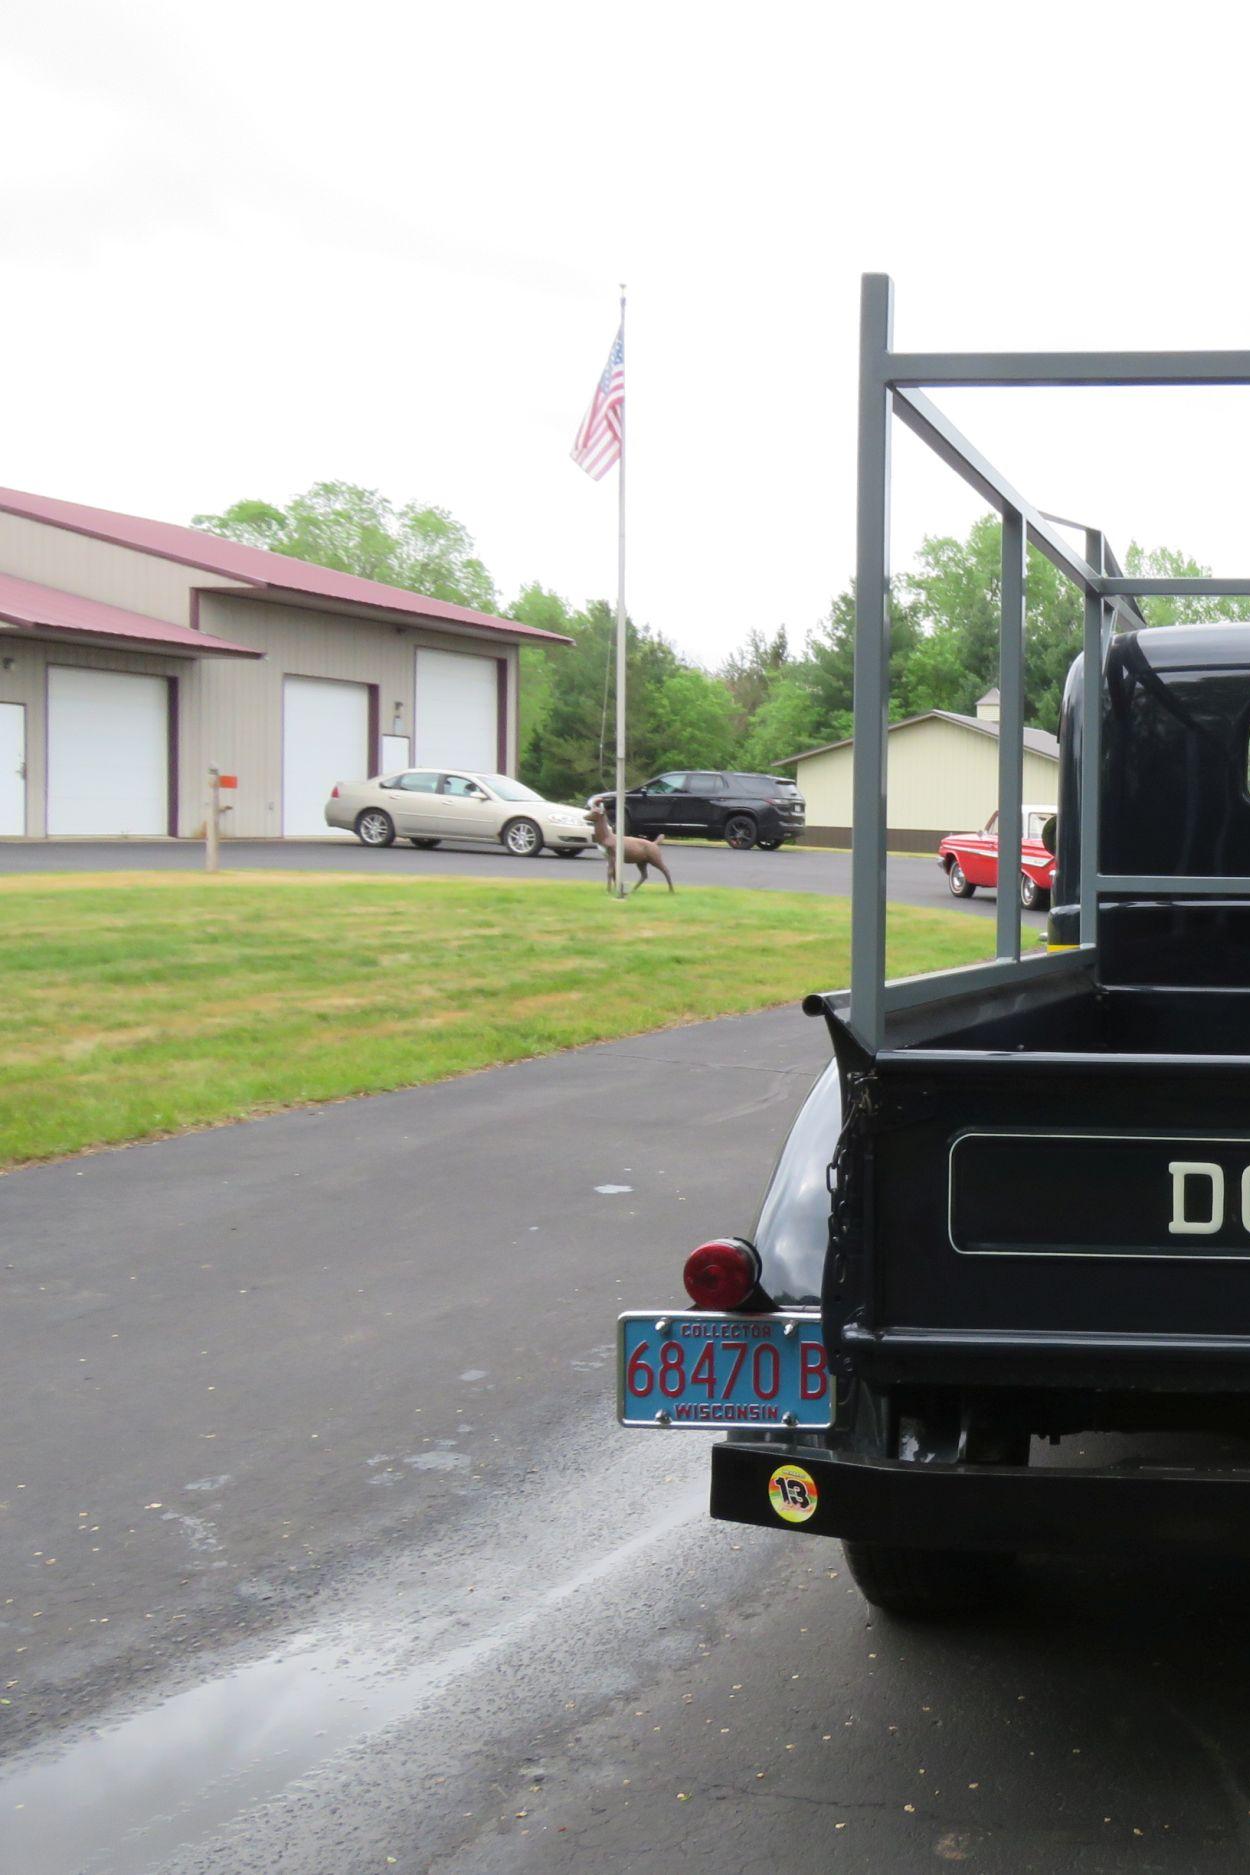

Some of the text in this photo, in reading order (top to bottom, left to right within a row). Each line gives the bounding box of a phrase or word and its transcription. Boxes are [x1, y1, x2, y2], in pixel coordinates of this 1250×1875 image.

[680, 1323, 774, 1339] COLLECTOR
[626, 1340, 828, 1400] 68470 B
[674, 1402, 779, 1420] WISCONSIN
[774, 1475, 811, 1510] 13
